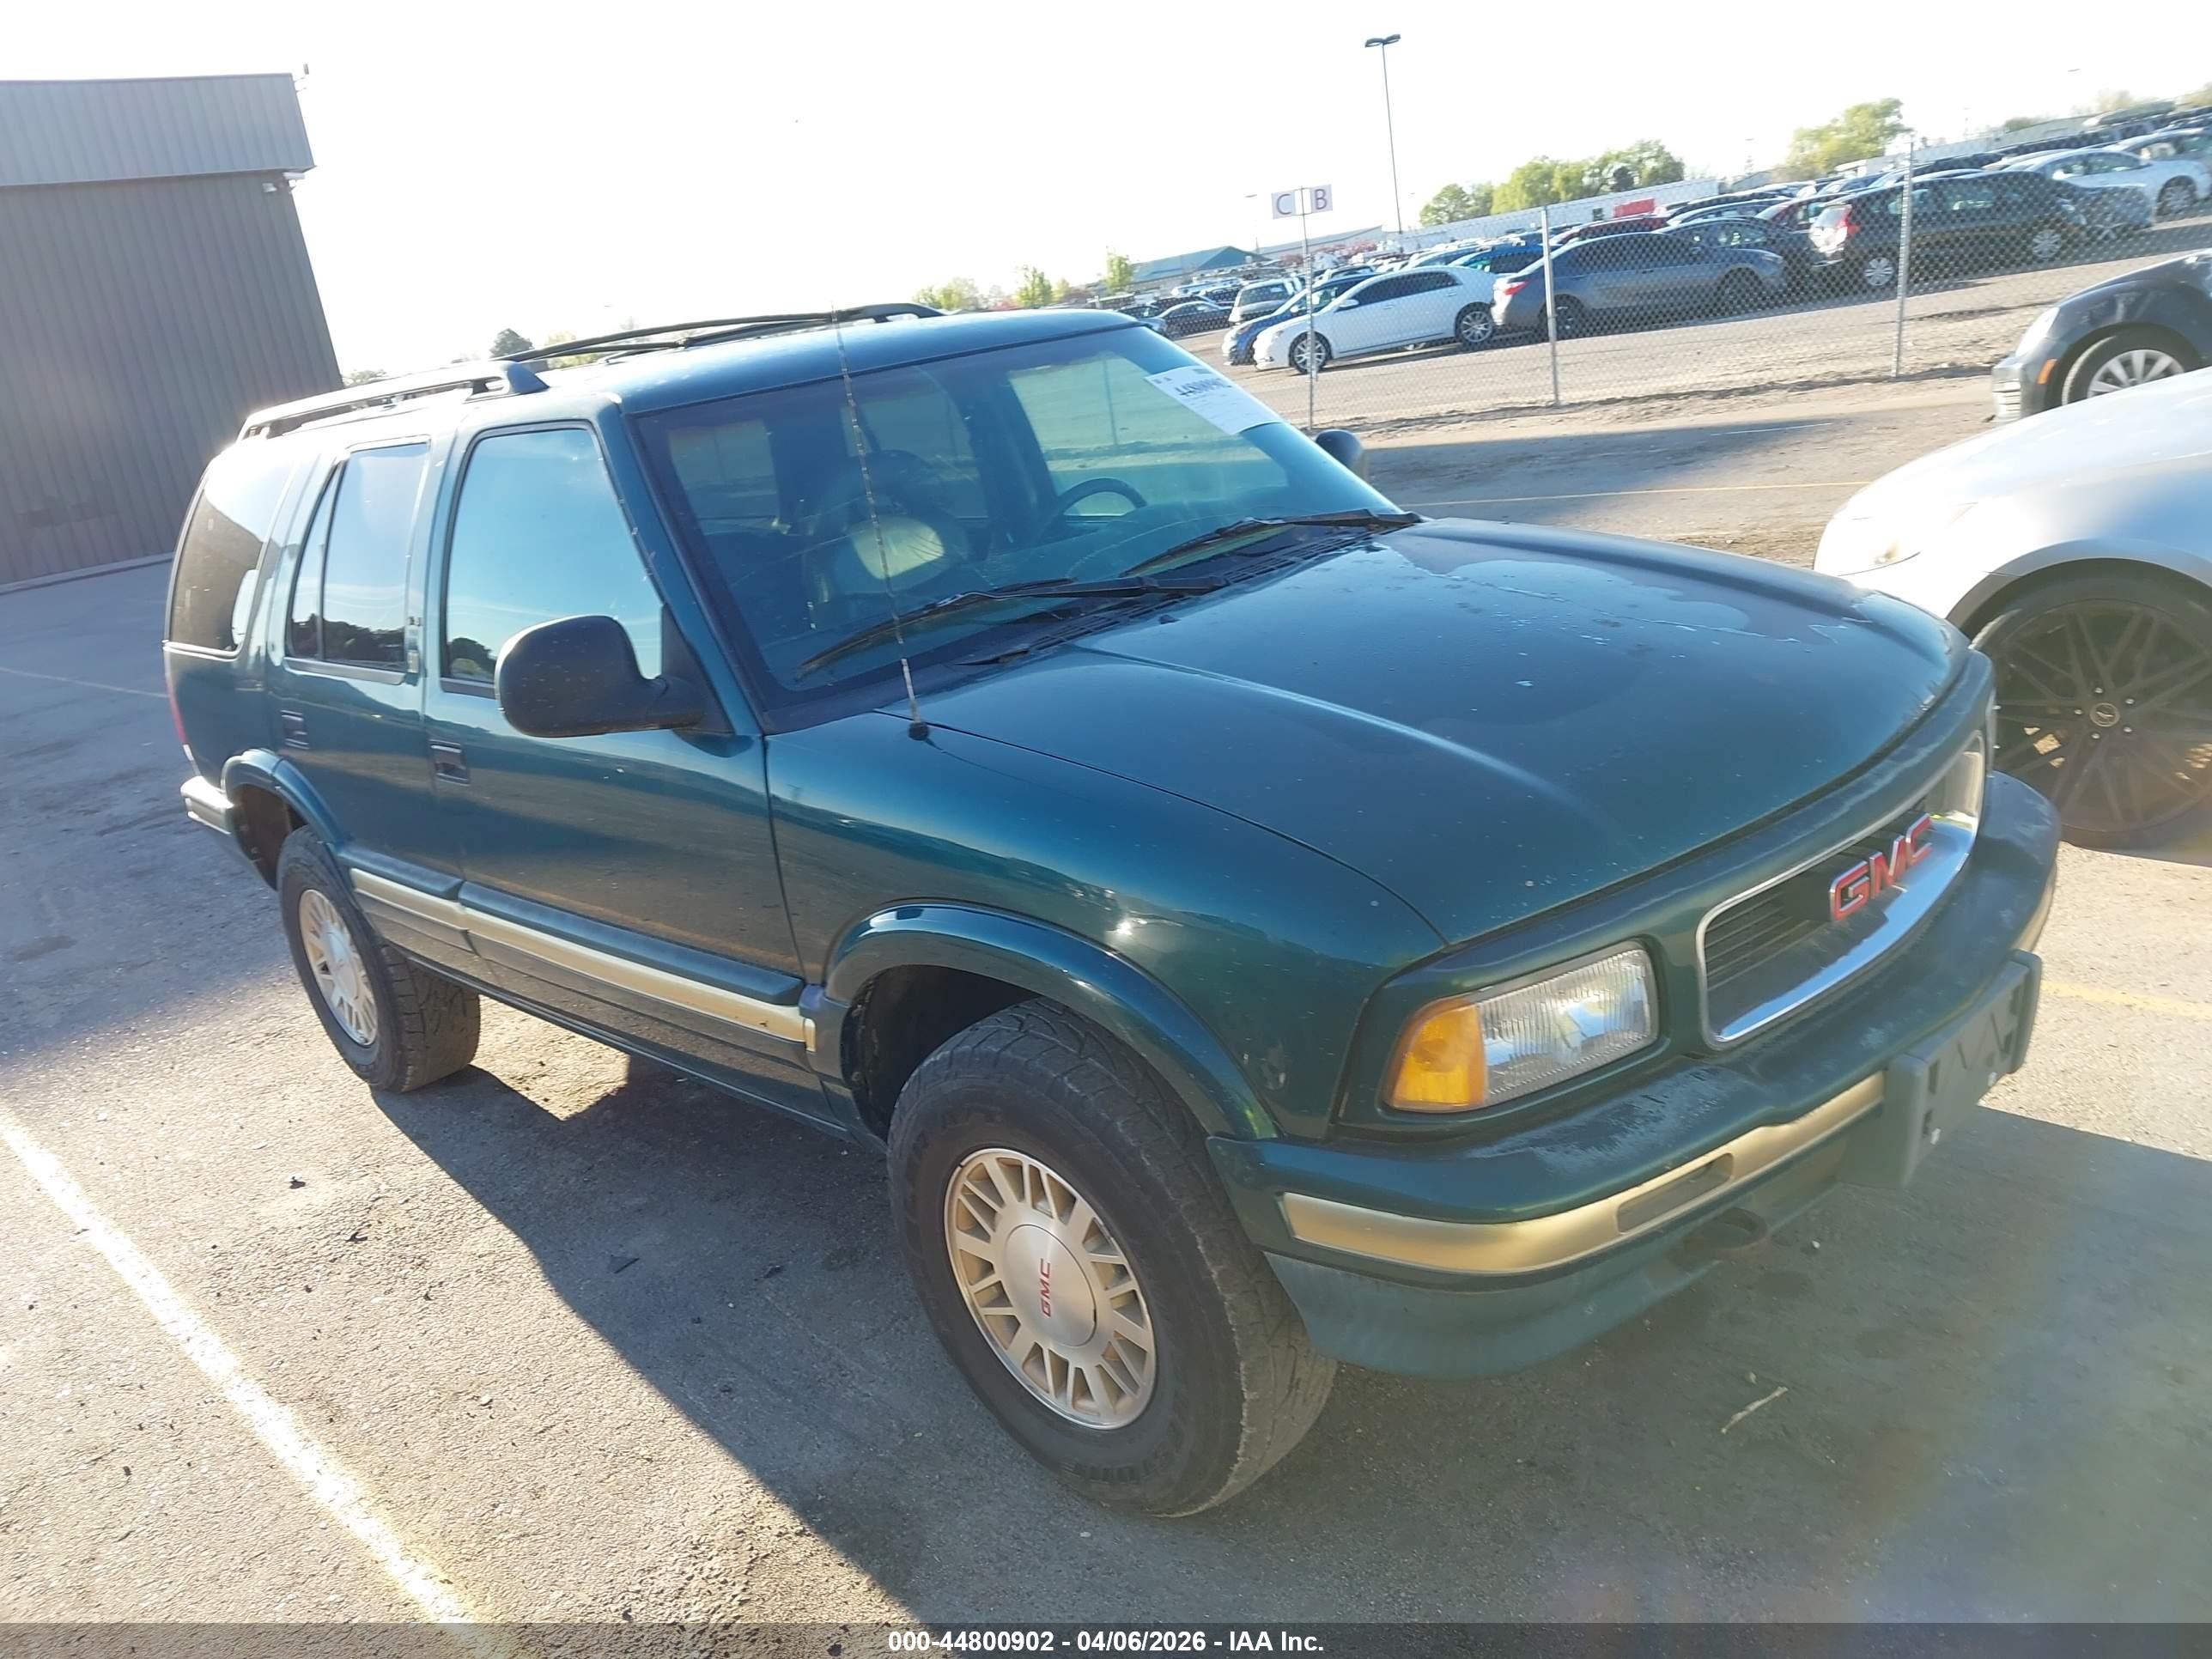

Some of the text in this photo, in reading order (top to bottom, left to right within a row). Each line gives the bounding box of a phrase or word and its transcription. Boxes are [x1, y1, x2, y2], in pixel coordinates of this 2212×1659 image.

[1276, 193, 1292, 215] C
[1315, 188, 1328, 210] B
[1830, 813, 1933, 921] GMC
[1040, 1258, 1051, 1317] GMC
